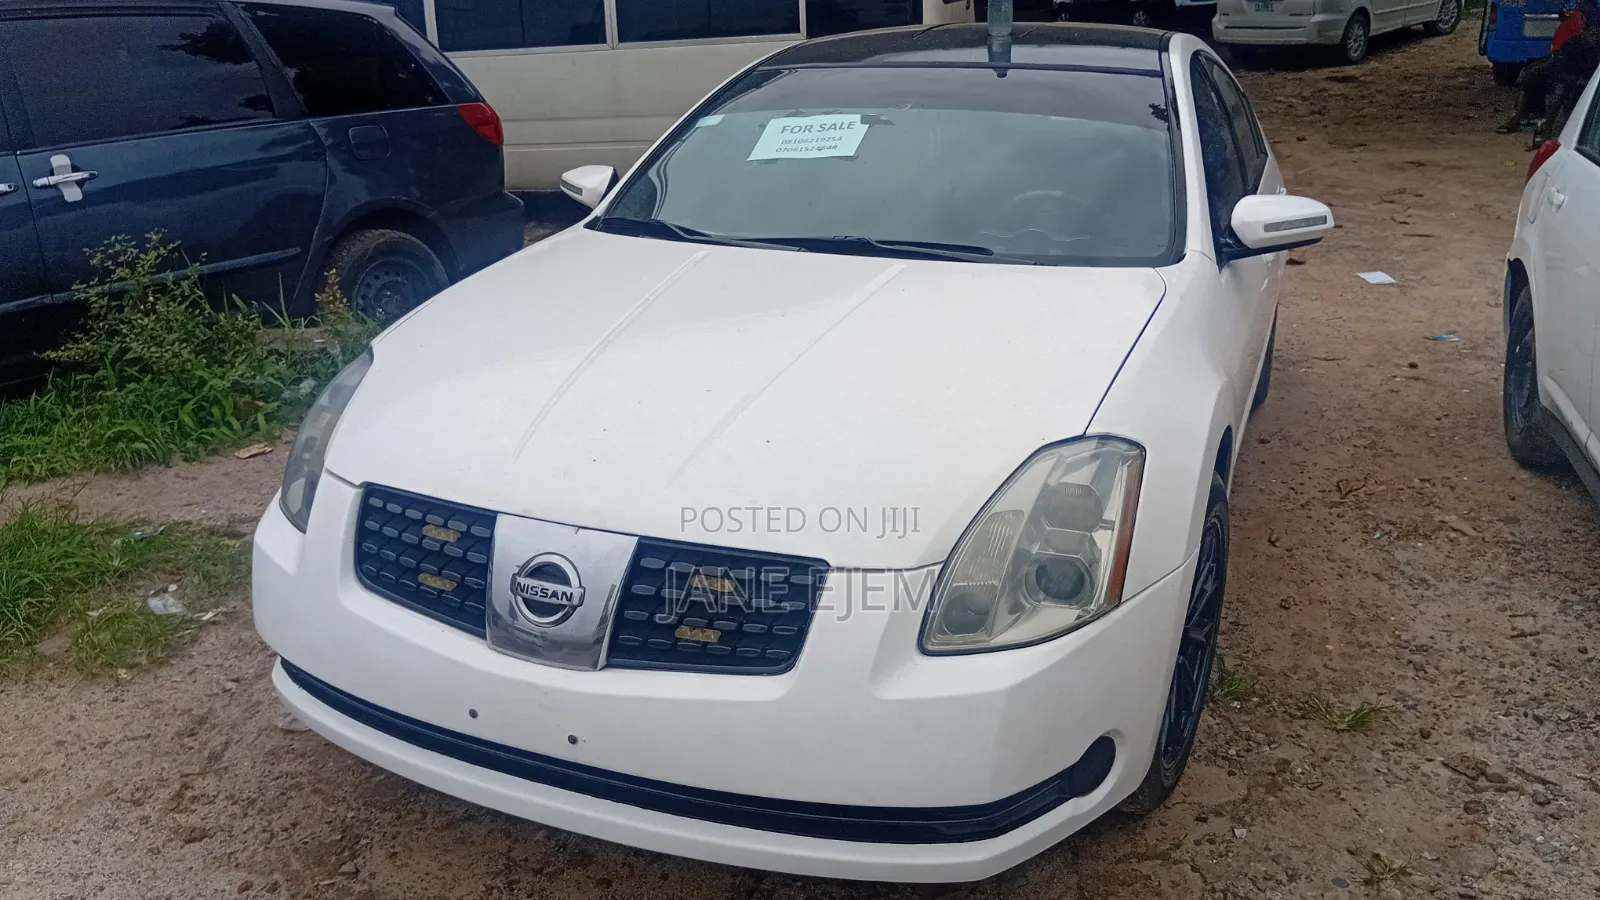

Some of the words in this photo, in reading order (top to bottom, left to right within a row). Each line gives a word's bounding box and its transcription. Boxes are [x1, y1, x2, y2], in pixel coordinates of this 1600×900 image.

[780, 124, 813, 135] FOR
[816, 121, 857, 132] SALE
[515, 581, 574, 602] NISSAN
